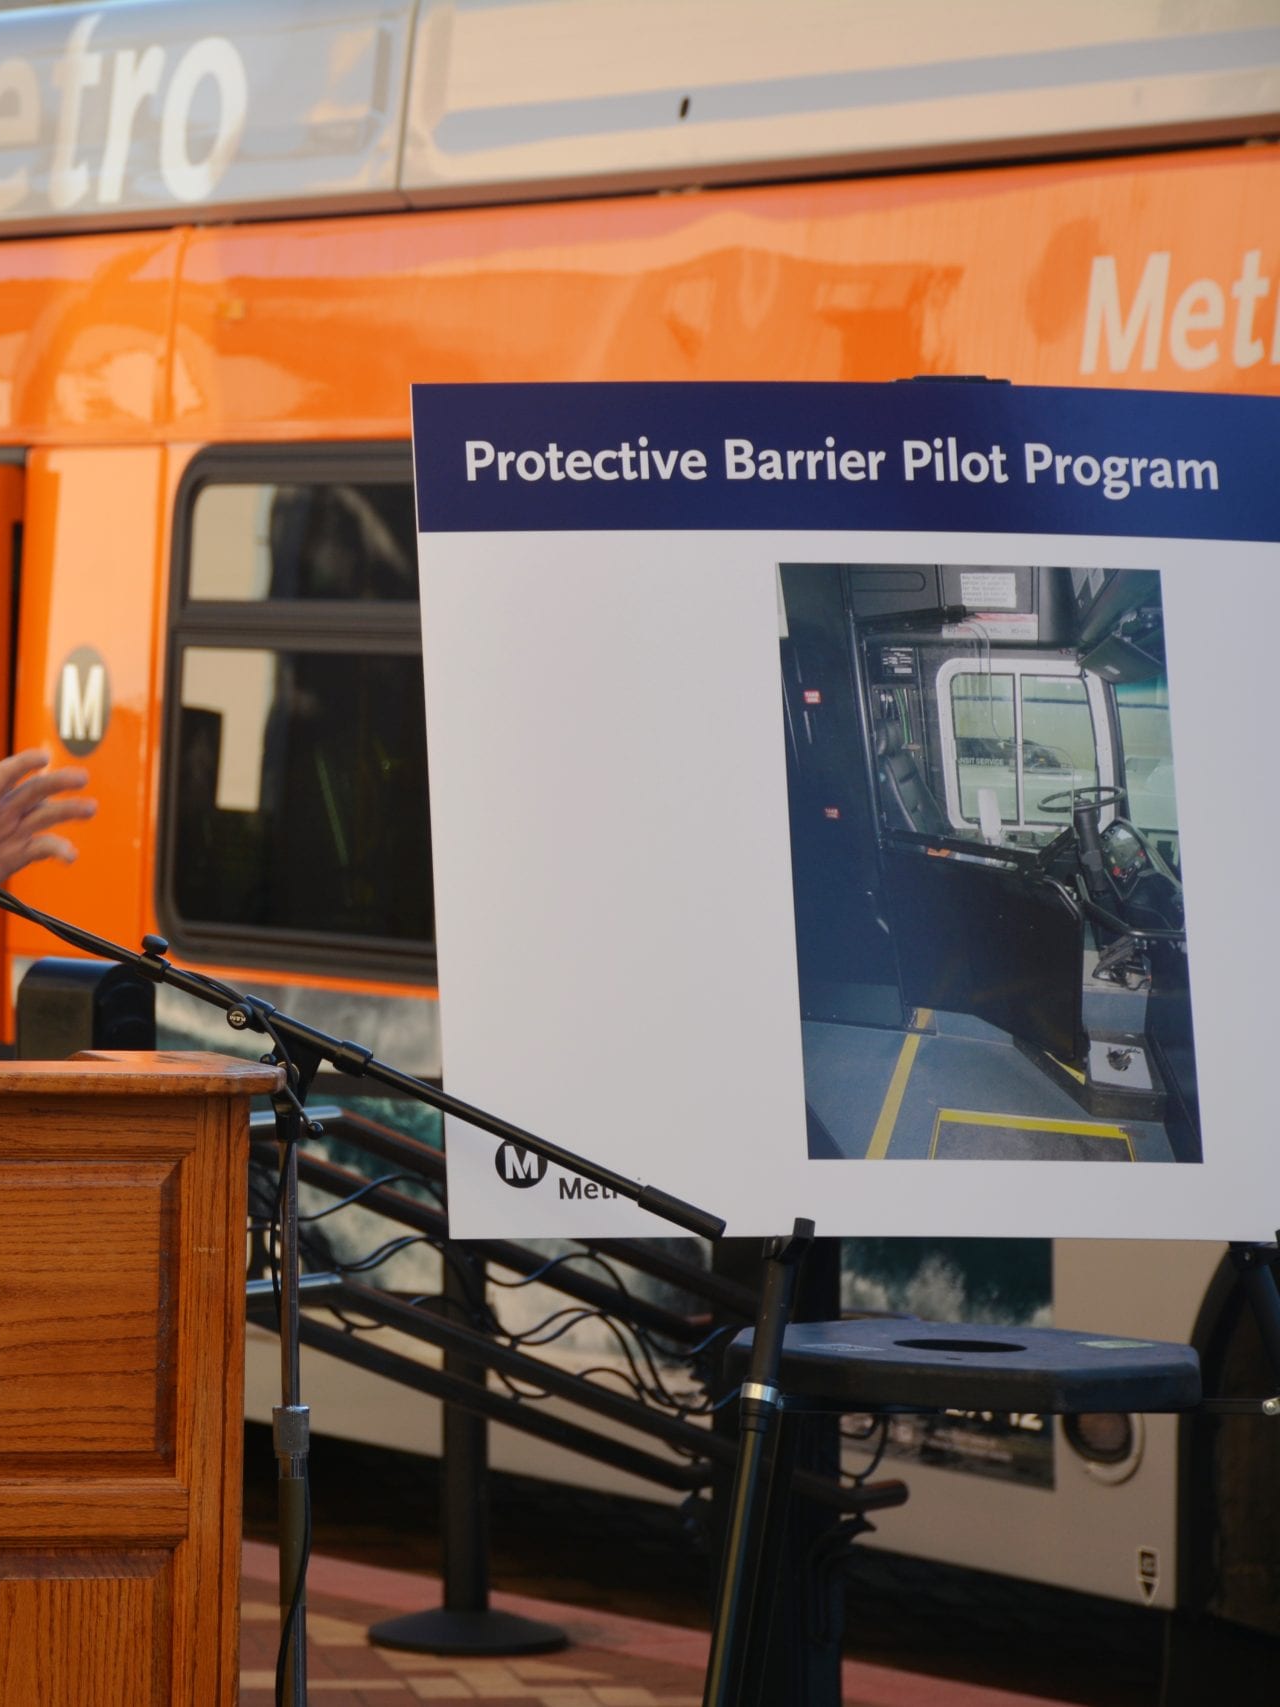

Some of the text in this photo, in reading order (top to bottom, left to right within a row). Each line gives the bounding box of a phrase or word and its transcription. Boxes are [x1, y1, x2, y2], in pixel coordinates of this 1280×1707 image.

[1079, 249, 1280, 376] Met
[465, 435, 1219, 500] Protective Barrier Pilot Program
[59, 663, 104, 741] M
[504, 1145, 539, 1180] M
[559, 1178, 618, 1200] Met
